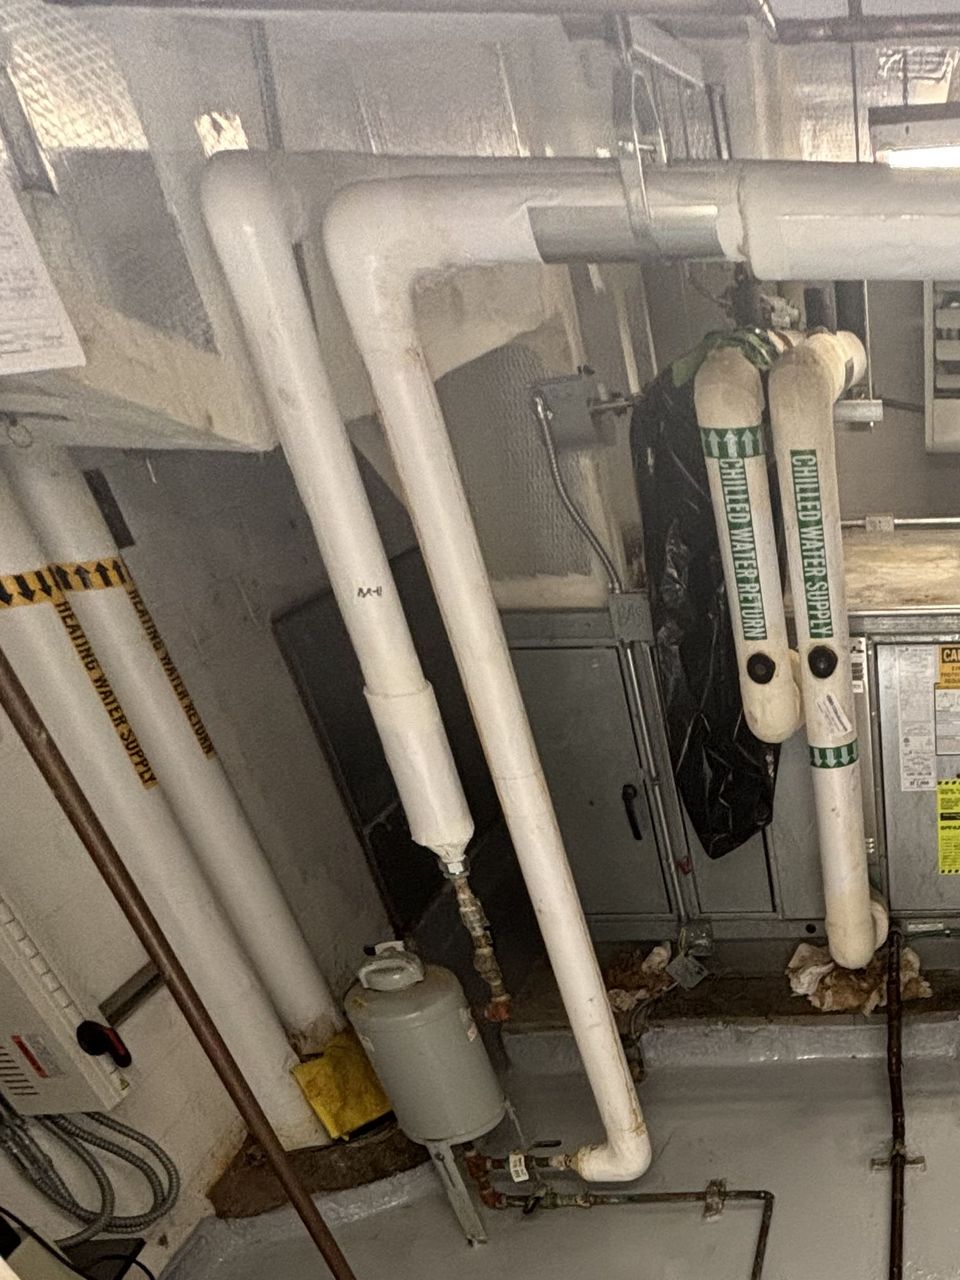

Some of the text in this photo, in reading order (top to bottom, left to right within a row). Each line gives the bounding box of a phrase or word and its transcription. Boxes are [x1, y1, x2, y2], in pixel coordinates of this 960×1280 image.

[719, 458, 767, 638] CHILLED WATER RETURN
[792, 455, 833, 636] CHILLED WATER SUPPLY
[56, 601, 158, 784] HEATING WATER SUPPLY
[128, 589, 215, 756] HEATING WATER RETURN
